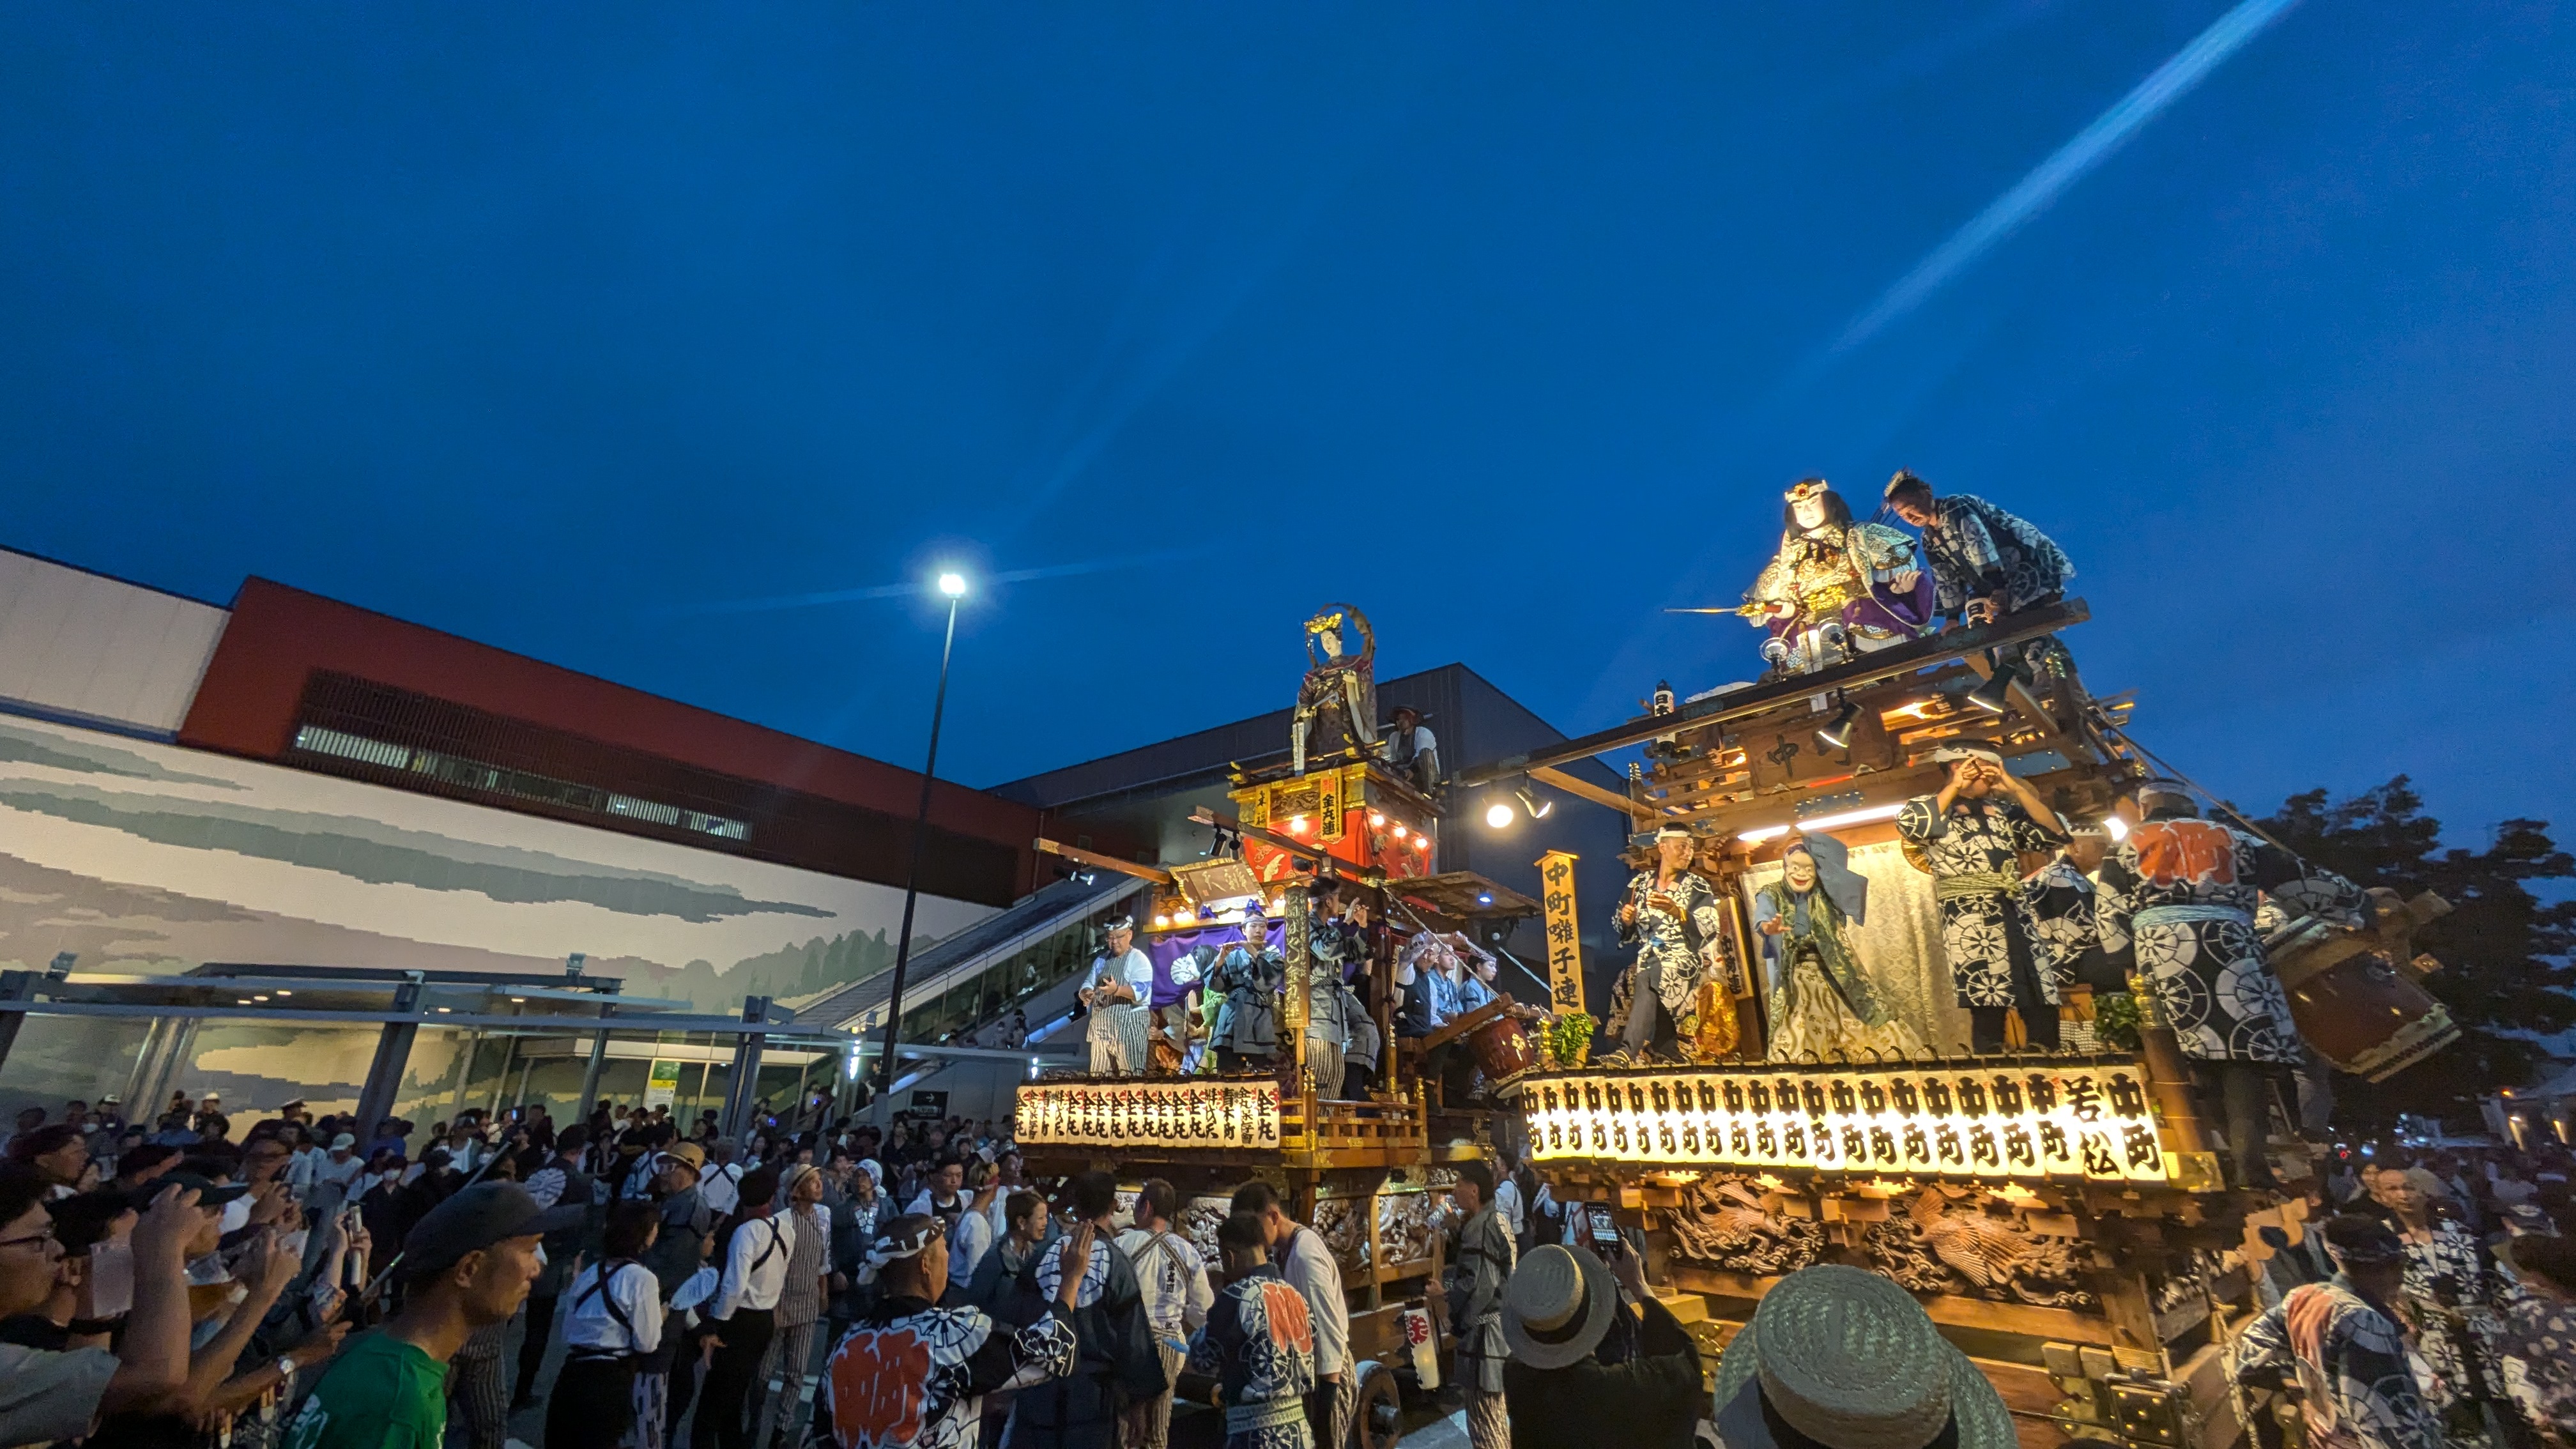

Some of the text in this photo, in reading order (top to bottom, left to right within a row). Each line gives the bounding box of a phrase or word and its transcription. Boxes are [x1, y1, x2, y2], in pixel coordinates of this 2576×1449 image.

[1545, 862, 1579, 1008] 中町囃子連
[1068, 1091, 1082, 1136] 金丸
[1082, 1091, 1098, 1137] 金丸
[1096, 1091, 1109, 1138] 金丸
[1111, 1092, 1126, 1138] 金丸
[1127, 1090, 1142, 1137] 金丸
[1142, 1089, 1157, 1137] 金丸
[1158, 1091, 1173, 1139] 金丸
[1173, 1091, 1189, 1139] 金丸
[1190, 1089, 1206, 1138] 金丸
[1257, 1089, 1276, 1140] 金丸
[1564, 1082, 1581, 1150] 中町
[1584, 1082, 1606, 1150] 中町
[1607, 1082, 1629, 1153] 中町
[1628, 1082, 1651, 1153] 中町
[1651, 1080, 1676, 1156] 中町
[1675, 1080, 1699, 1156] 中町
[1698, 1080, 1722, 1155] 中町
[1722, 1080, 1751, 1157] 中町
[1749, 1079, 1777, 1158] 中町
[1776, 1078, 1807, 1158] 中町
[1802, 1080, 1835, 1162] 中町
[1830, 1079, 1867, 1164] 中町
[1859, 1080, 1896, 1164] 中町
[1890, 1078, 1929, 1165] 中町
[1922, 1078, 1964, 1167] 中町
[1956, 1077, 1999, 1167] 中町
[1991, 1075, 2036, 1167] 中町
[2028, 1074, 2070, 1161] 中町
[2063, 1077, 2119, 1175] 若松
[2106, 1073, 2162, 1172] 中町
